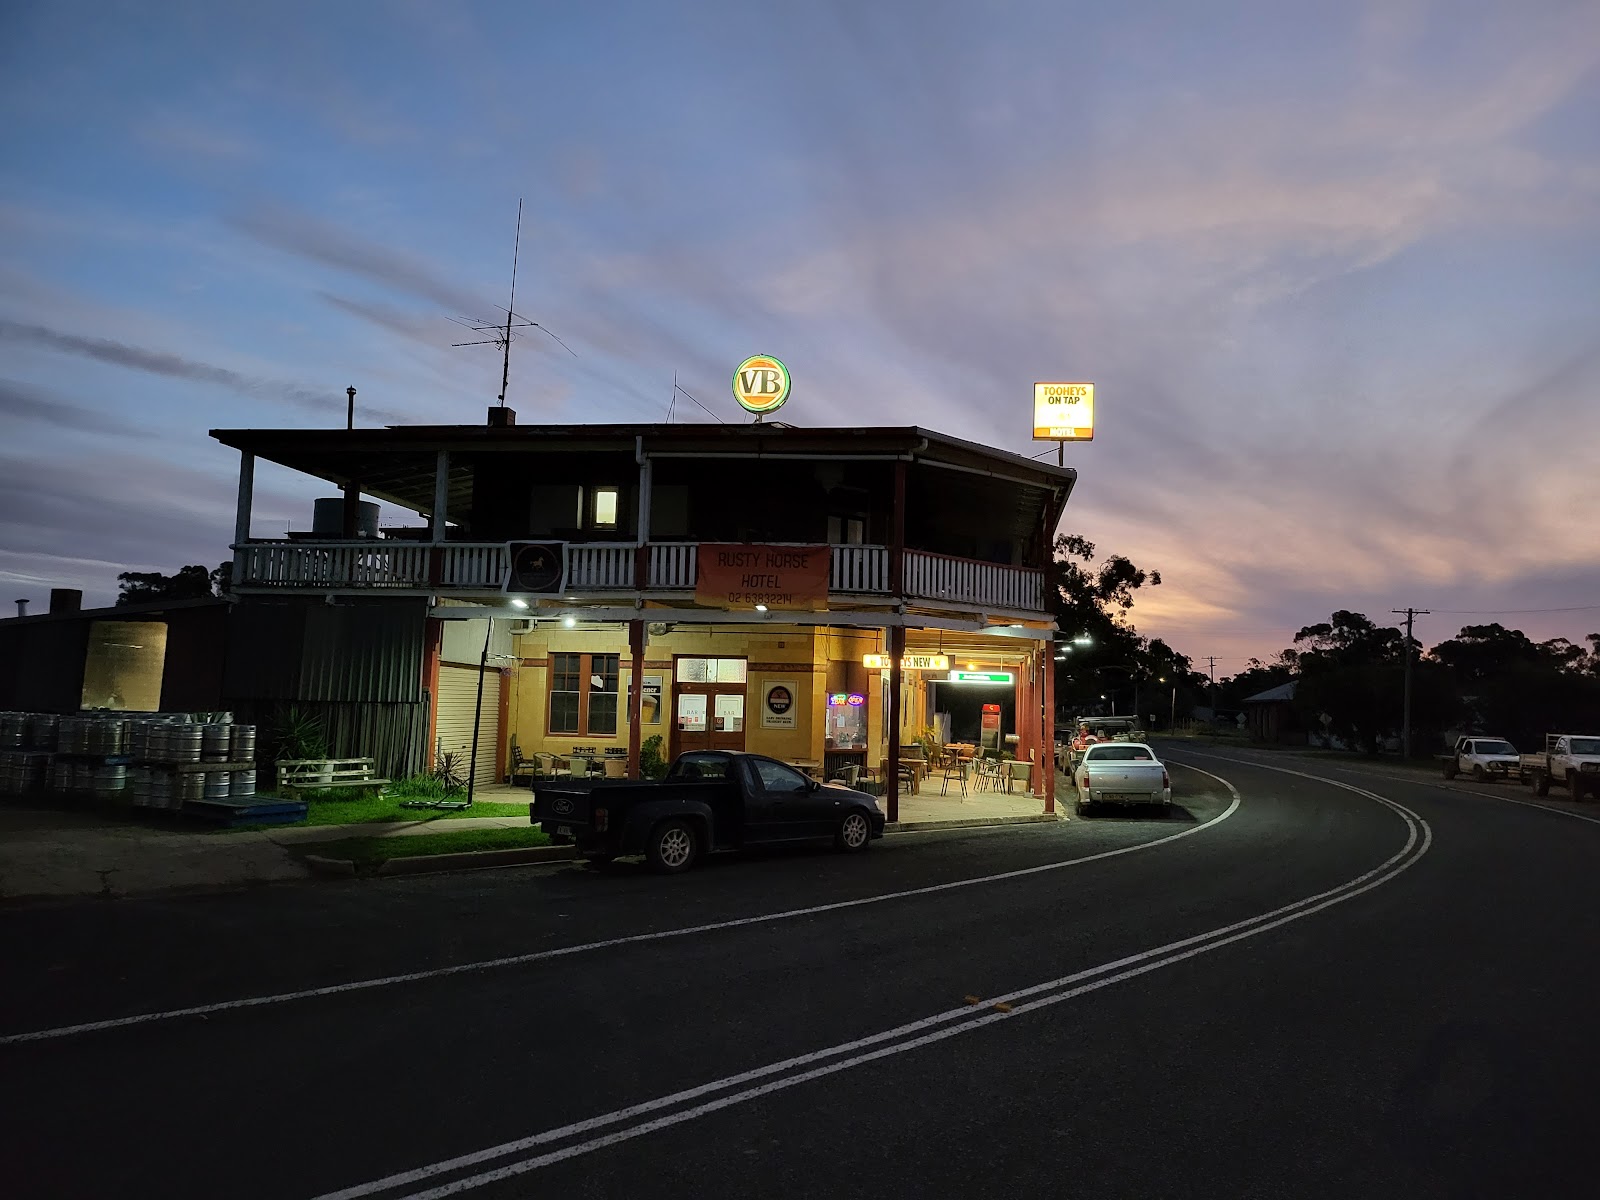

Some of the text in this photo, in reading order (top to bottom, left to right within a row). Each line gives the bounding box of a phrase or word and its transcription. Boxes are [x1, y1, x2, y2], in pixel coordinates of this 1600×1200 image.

[740, 369, 781, 394] VB
[1043, 386, 1087, 396] TOOHEYS
[1048, 396, 1080, 405] ON TAP
[718, 552, 809, 569] RUSTY HORSE
[741, 574, 782, 589] HOTEL
[728, 592, 792, 605] 02 63832214
[880, 656, 931, 668] TOEYS NEW
